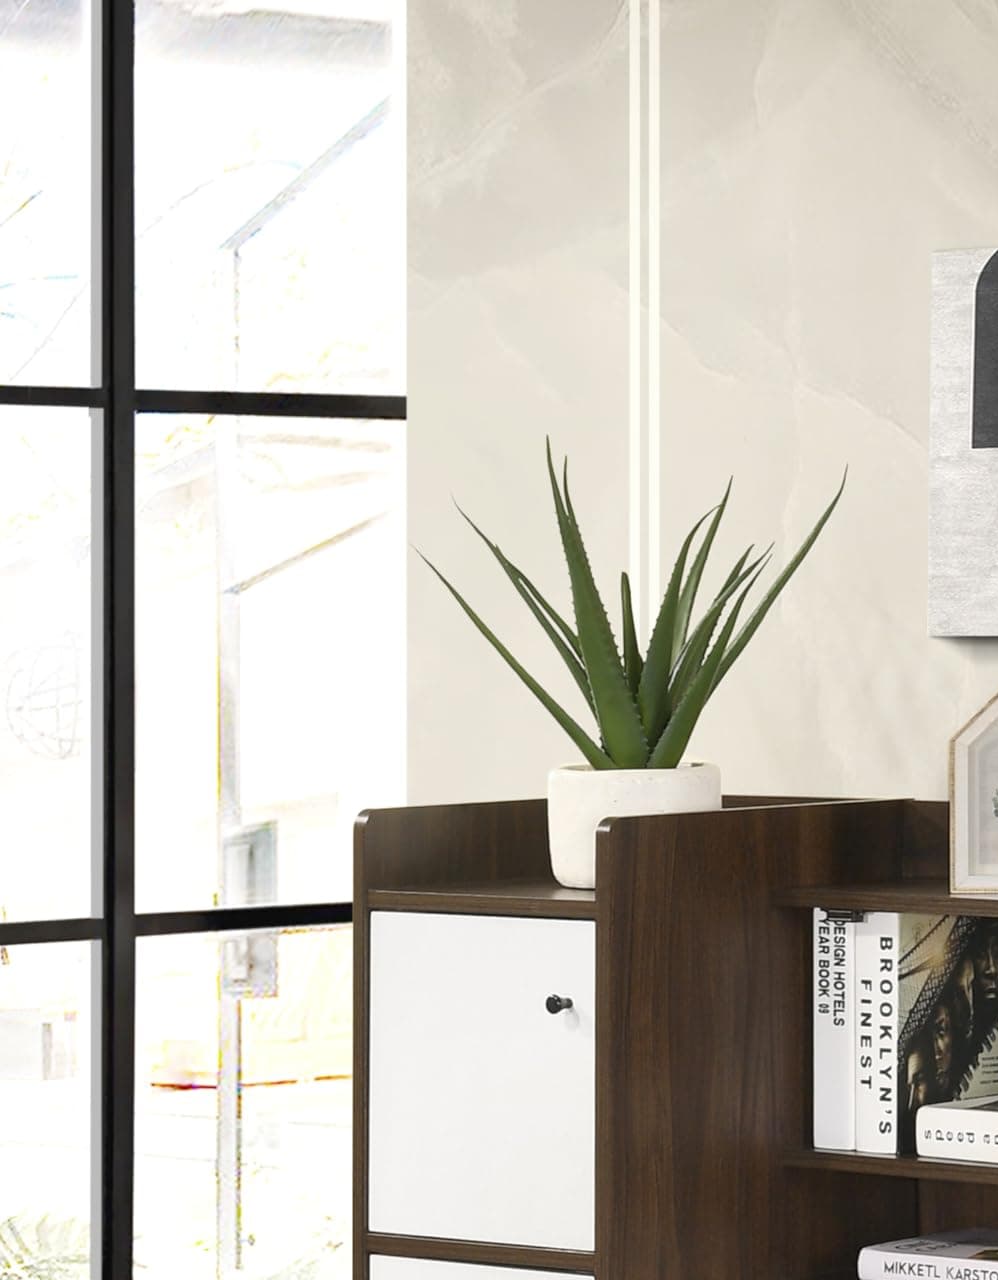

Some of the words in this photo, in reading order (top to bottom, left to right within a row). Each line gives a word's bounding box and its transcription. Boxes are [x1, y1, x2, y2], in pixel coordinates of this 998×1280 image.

[818, 959, 830, 998] BOOK
[833, 971, 846, 1027] HOTELS
[860, 979, 873, 1090] FINEST
[878, 936, 894, 1135] BROOKLYN'S
